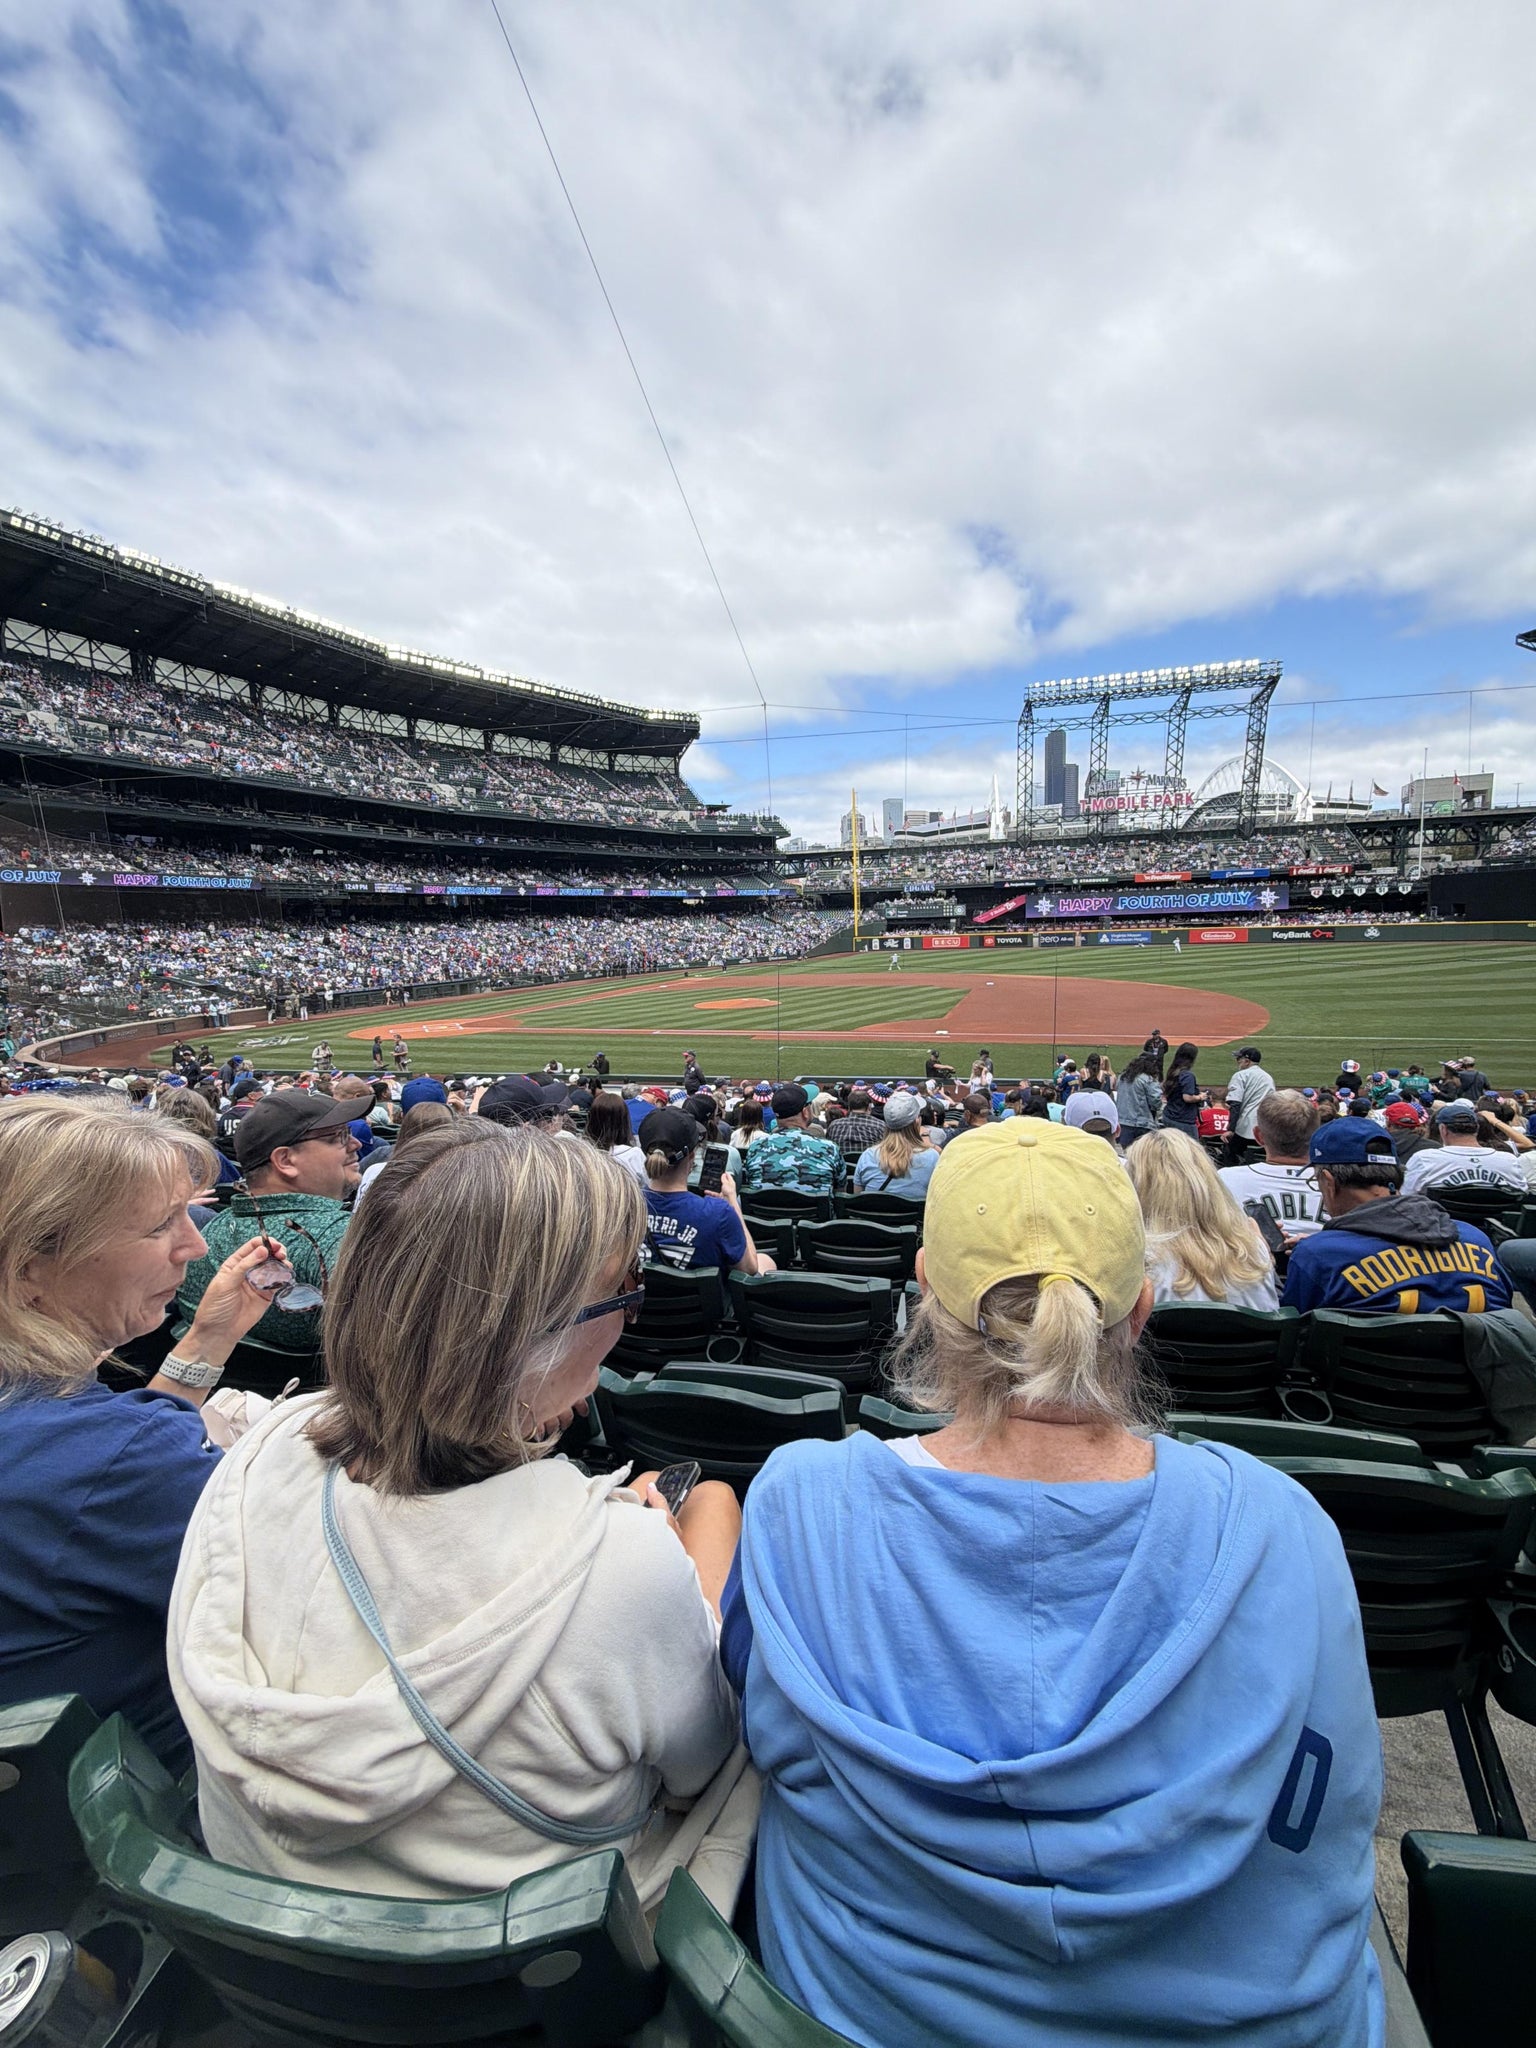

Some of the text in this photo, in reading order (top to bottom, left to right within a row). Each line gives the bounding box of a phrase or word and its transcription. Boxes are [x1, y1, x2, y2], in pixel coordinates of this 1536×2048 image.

[1147, 774, 1187, 789] MARINERS
[1080, 792, 1195, 813] T-MOBILE PARK
[0, 869, 61, 883] OF JULY
[113, 874, 252, 889] HAPPY FOURTH OF JULY
[1060, 891, 1251, 911] HAPPY FOURTH OF JULY
[934, 938, 959, 946] BECU
[1272, 930, 1311, 940] KeyBank
[1214, 1120, 1229, 1131] 97
[677, 1225, 698, 1246] JR.
[1341, 1241, 1498, 1298] RODRIGUEZ
